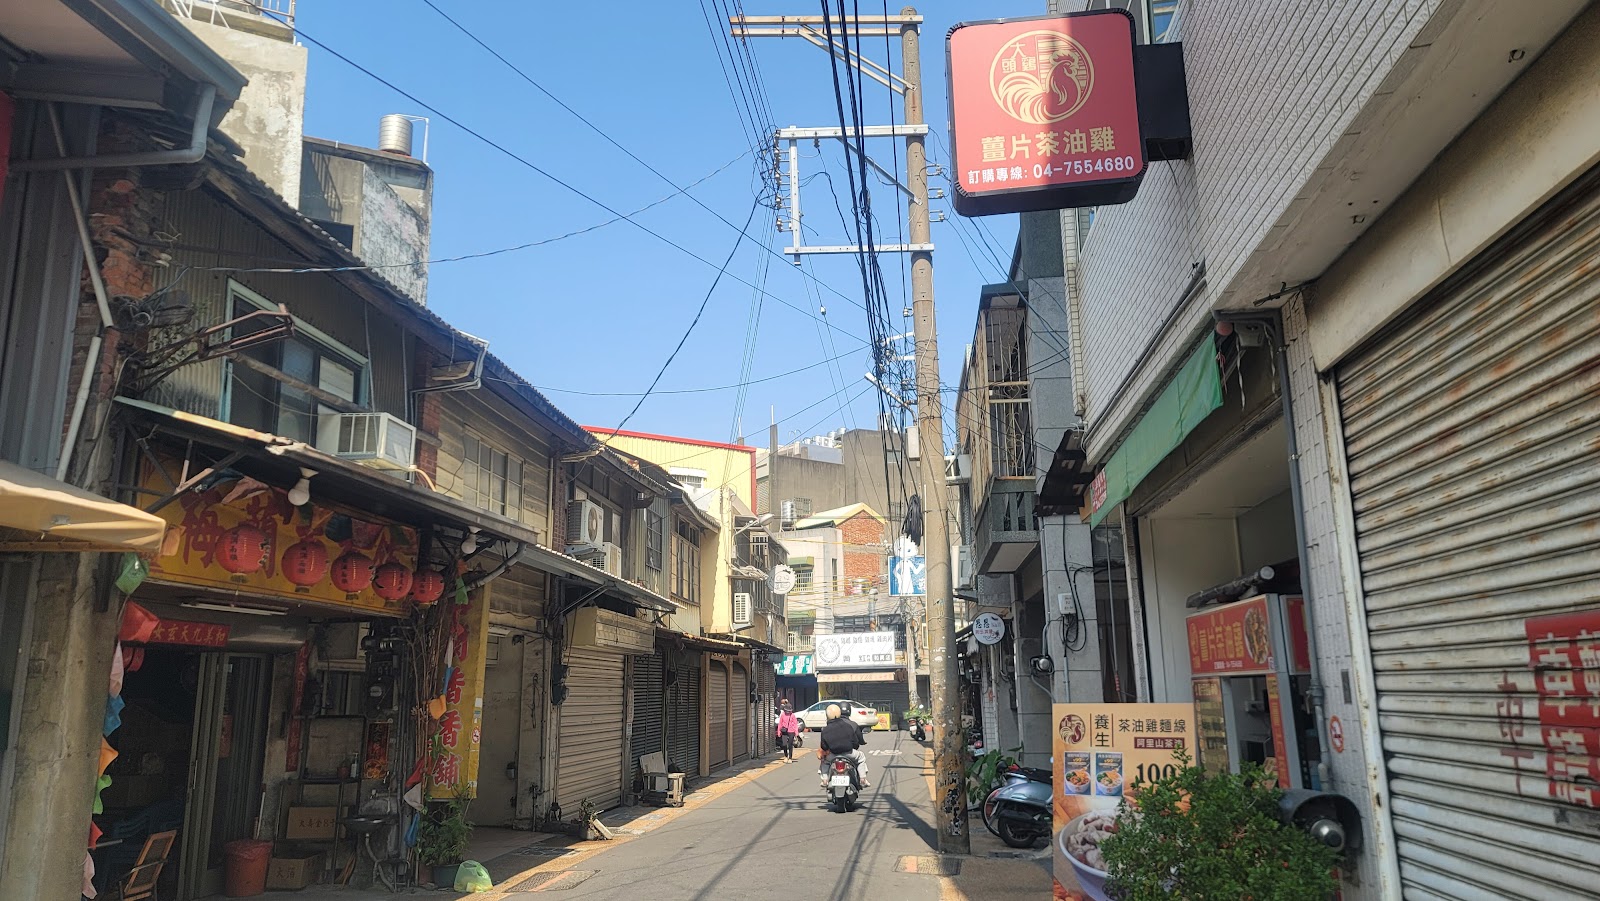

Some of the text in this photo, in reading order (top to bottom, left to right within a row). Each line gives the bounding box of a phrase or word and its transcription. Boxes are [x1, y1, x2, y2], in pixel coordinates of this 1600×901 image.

[981, 126, 1116, 163] 薑片茶油雞
[1033, 156, 1135, 179] 04-7554680
[1094, 714, 1110, 747] 養生
[1118, 718, 1187, 733] 茶油雞麵線
